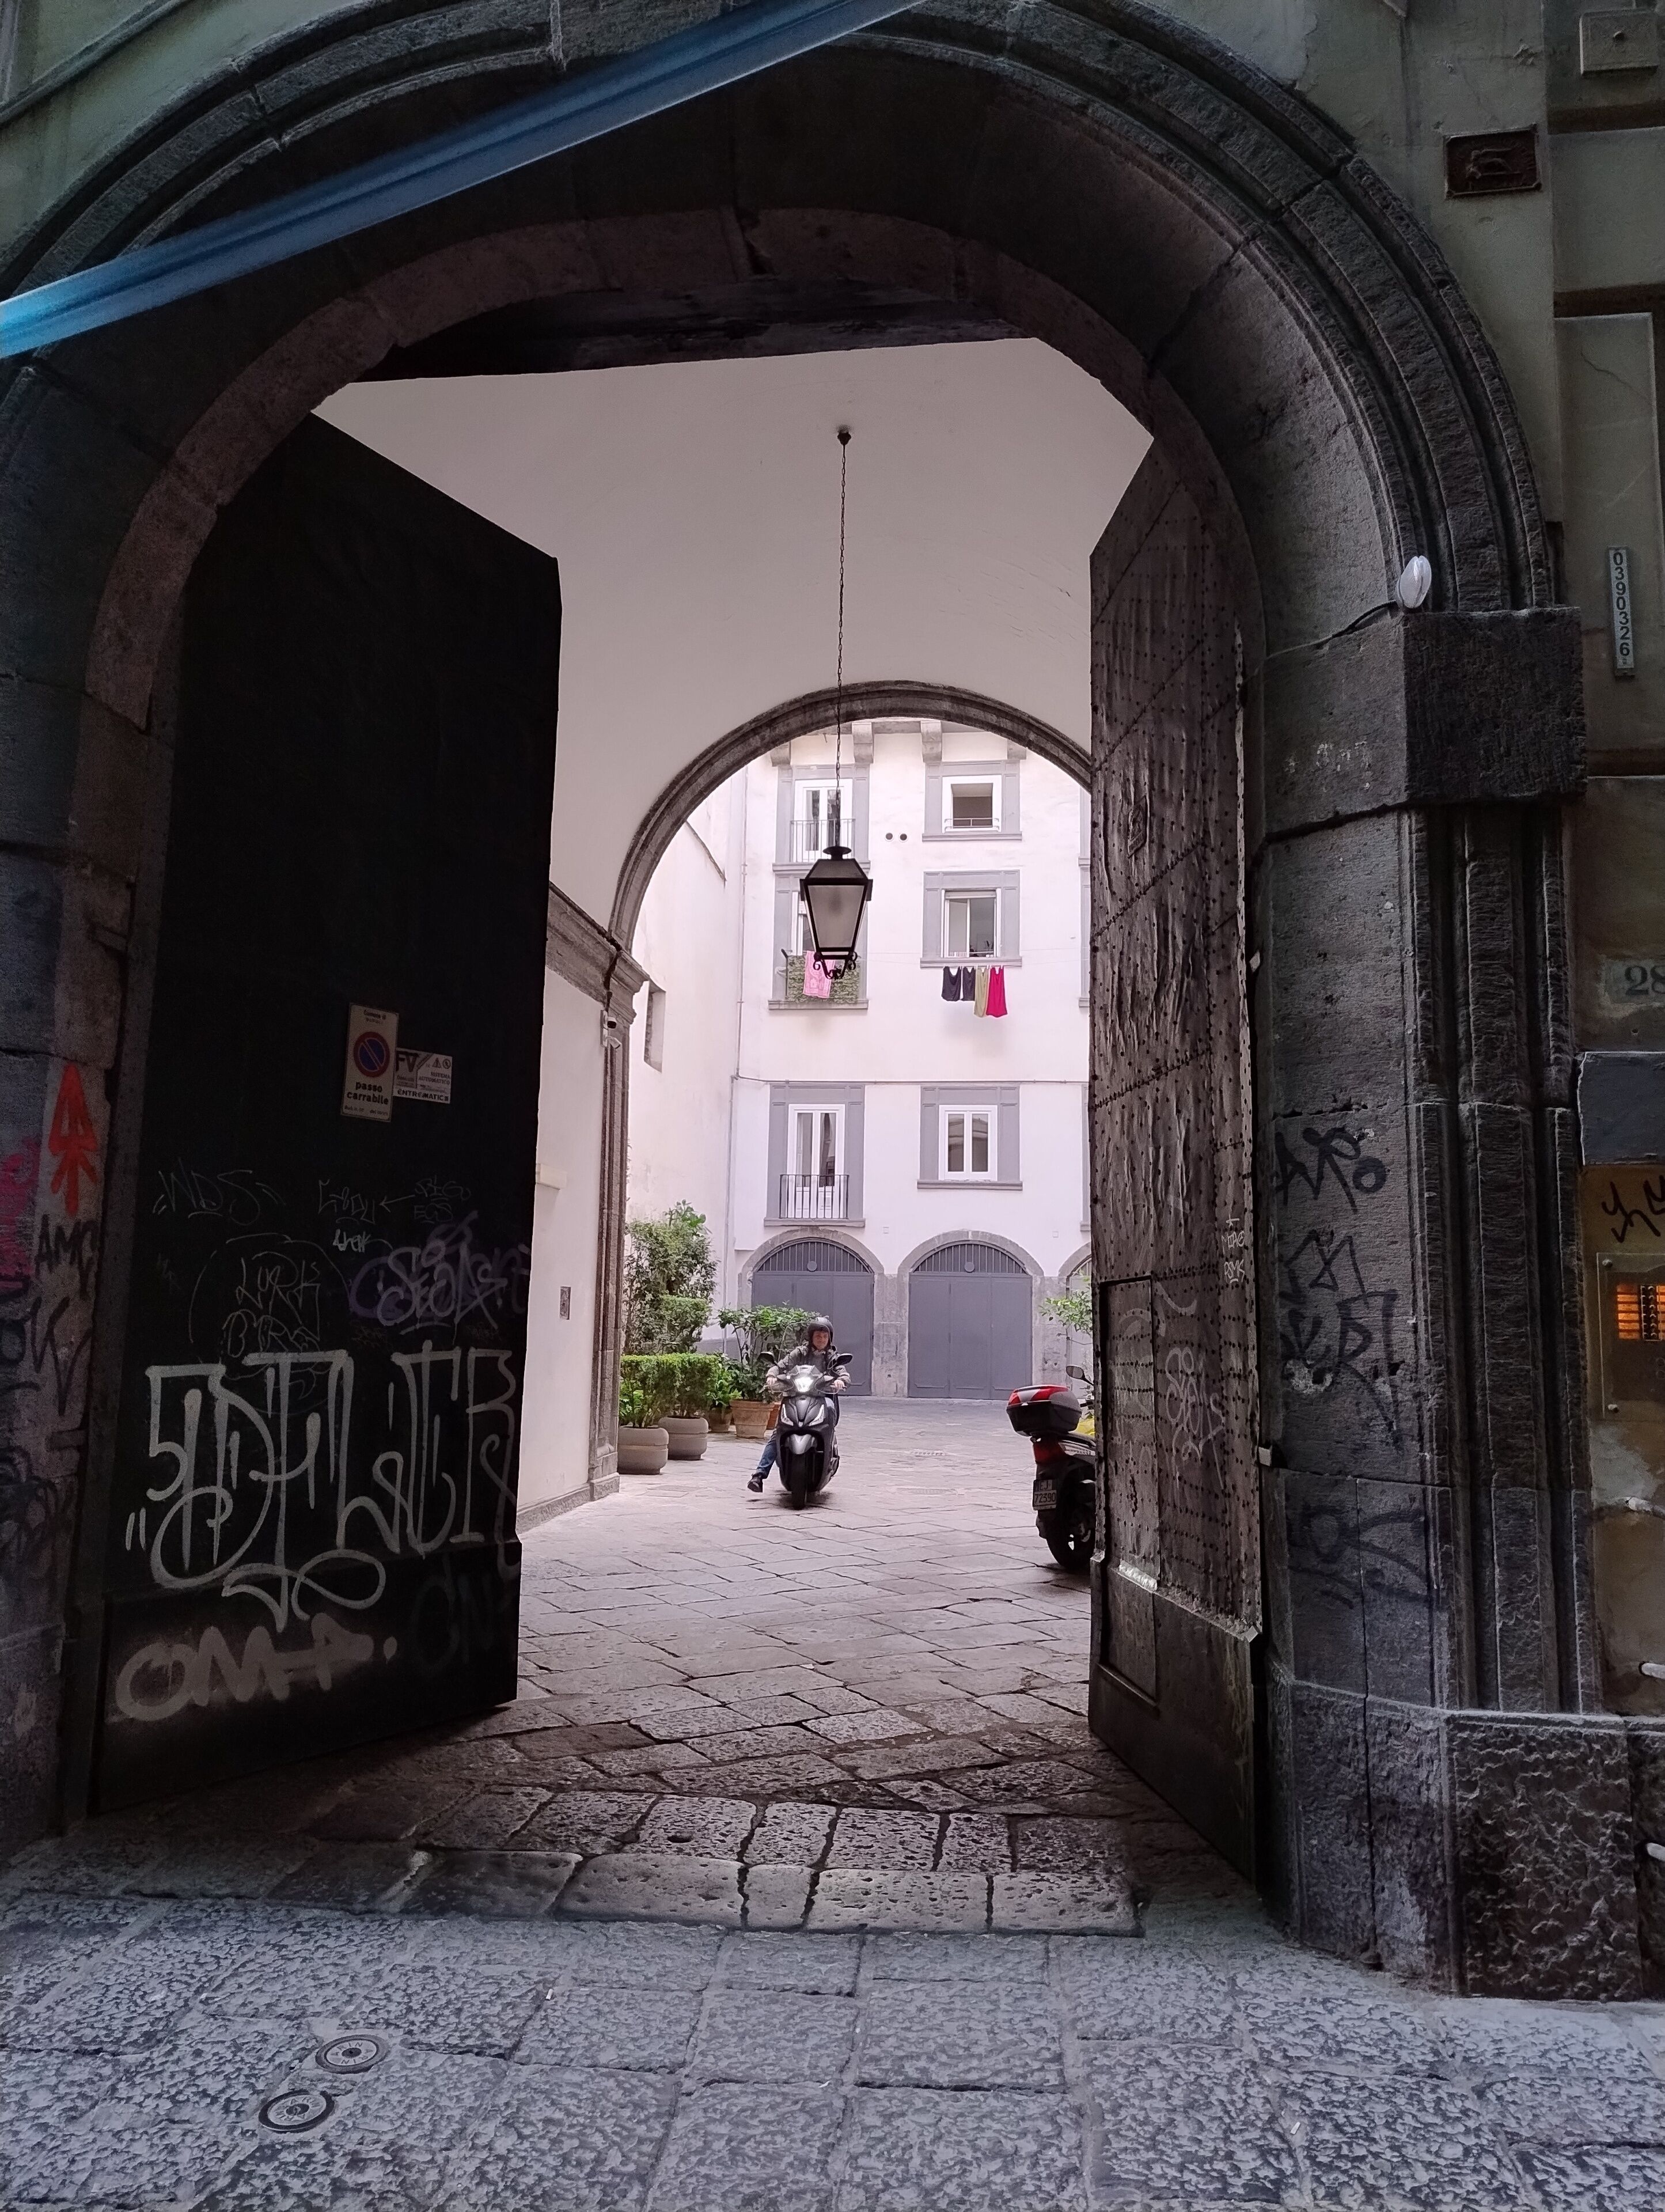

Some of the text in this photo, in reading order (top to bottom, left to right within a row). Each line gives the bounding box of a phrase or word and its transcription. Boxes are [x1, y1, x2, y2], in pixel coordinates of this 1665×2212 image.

[1613, 551, 1630, 657] 0390326
[355, 1081, 382, 1093] passo
[347, 1092, 389, 1105] carrabile
[397, 1089, 443, 1101] ENTREMATIC
